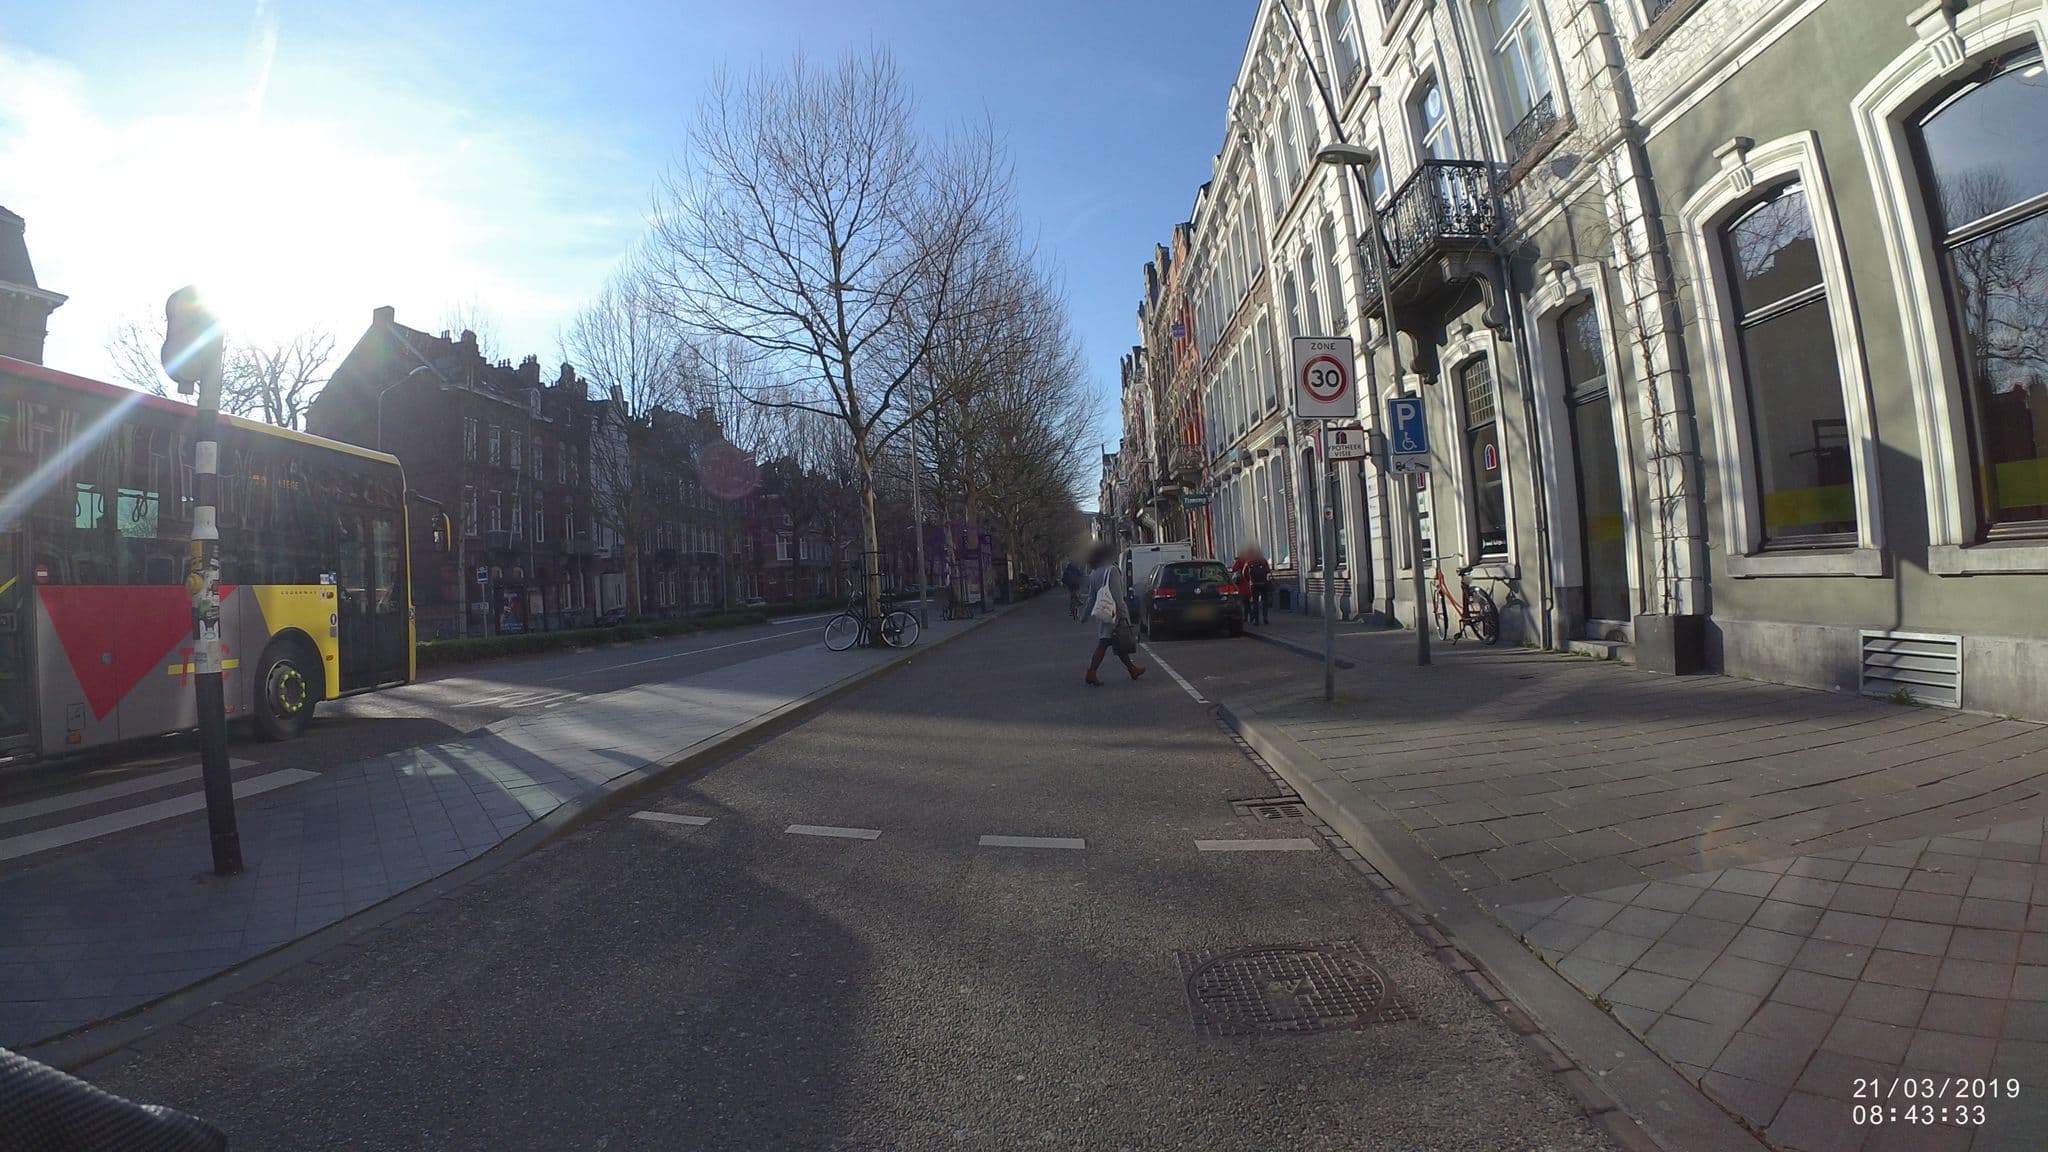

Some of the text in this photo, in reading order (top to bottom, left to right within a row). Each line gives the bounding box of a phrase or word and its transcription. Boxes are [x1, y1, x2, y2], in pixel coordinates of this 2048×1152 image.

[1311, 342, 1336, 351] ZONE
[1310, 369, 1340, 388] 30
[1396, 403, 1416, 431] P
